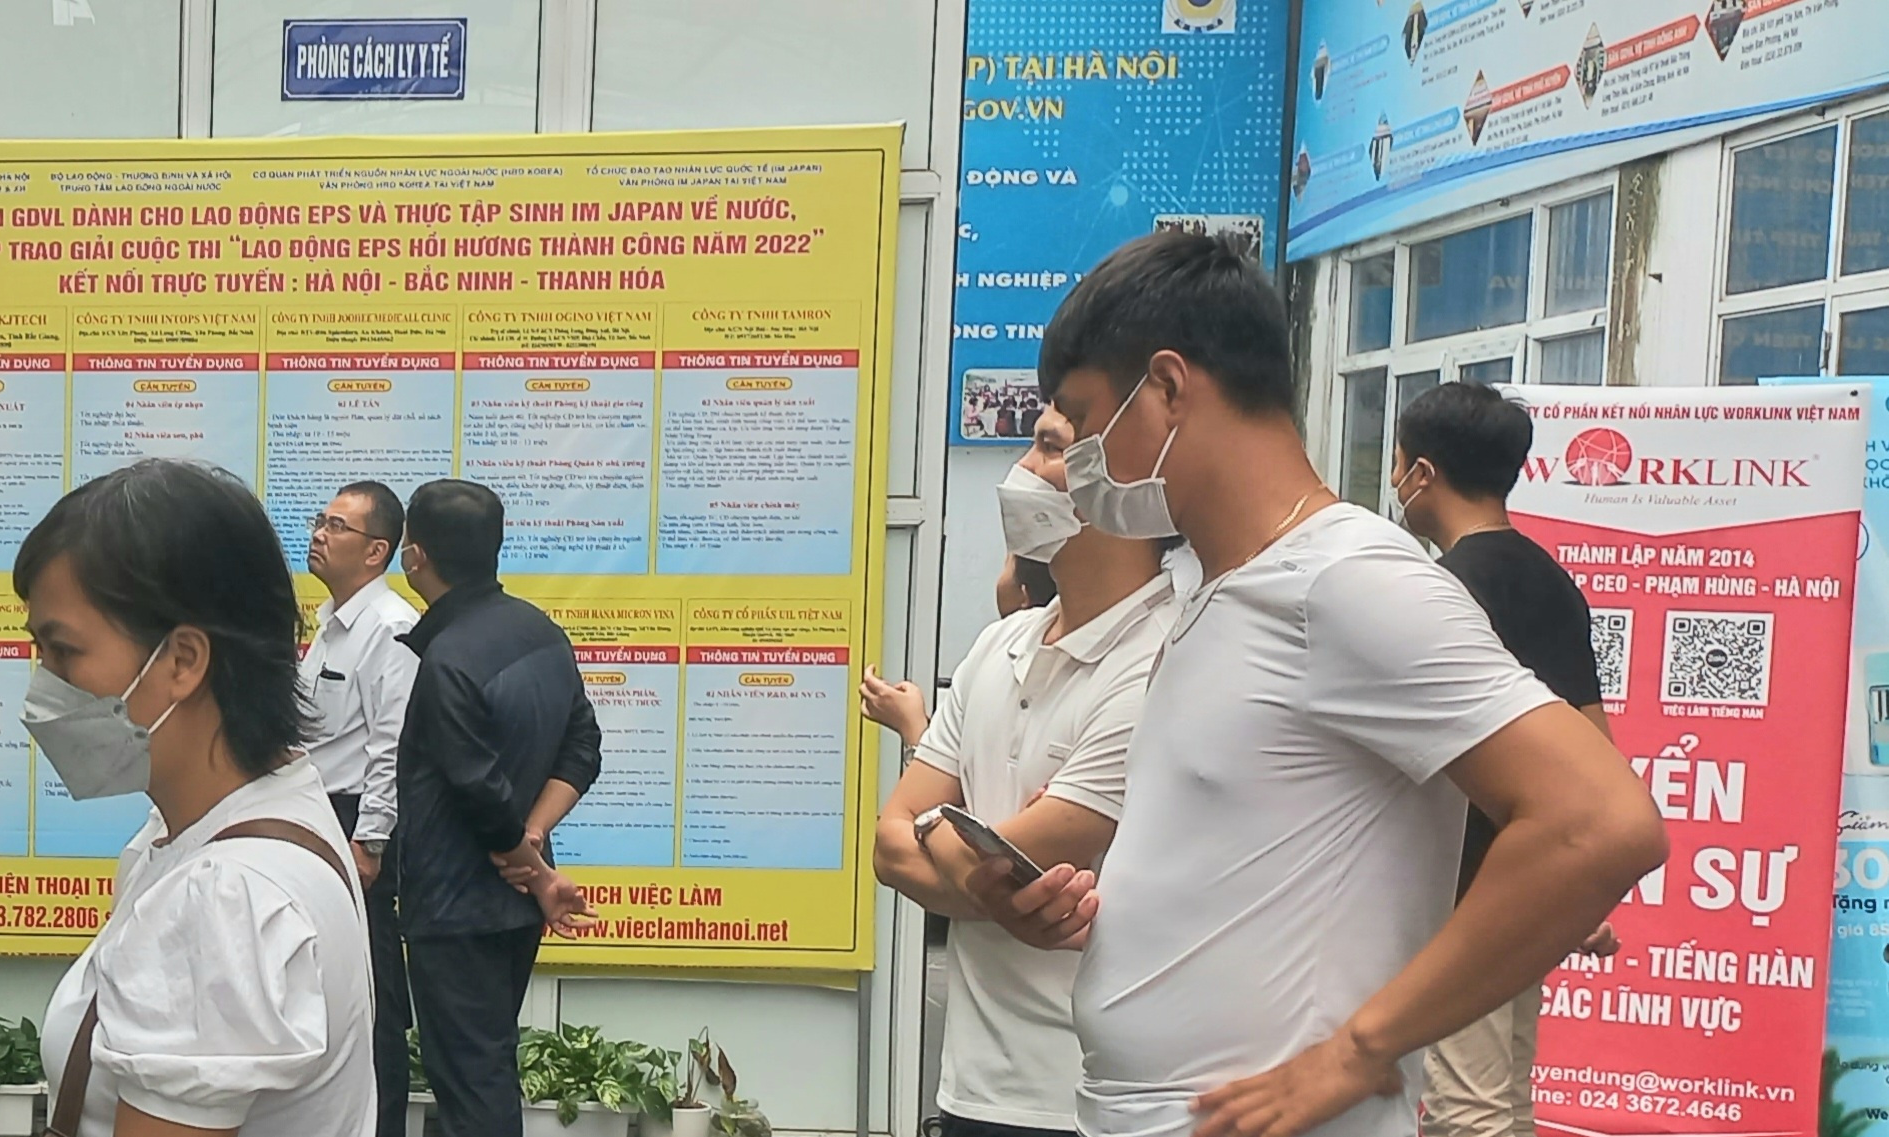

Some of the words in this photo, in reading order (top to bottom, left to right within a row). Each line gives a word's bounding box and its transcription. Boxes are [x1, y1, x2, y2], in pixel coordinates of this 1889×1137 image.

[297, 36, 350, 79] PHÒNG
[353, 36, 394, 79] CÁCH
[398, 43, 415, 78] LY
[420, 43, 428, 78] Y
[432, 32, 452, 78] TẾ
[1004, 56, 1055, 84] TẠI
[1063, 49, 1107, 80] HÀ
[1115, 51, 1177, 85] NỘI
[967, 169, 1038, 188] ĐỘNG
[1046, 168, 1077, 184] VÀ
[11, 207, 64, 227] GDVL
[72, 202, 132, 227] DÀNH
[140, 205, 183, 226] CHO
[191, 206, 232, 226] LAO
[239, 202, 300, 230] ĐỘNG
[308, 204, 350, 225] EPS
[358, 199, 387, 224] VÀ
[395, 201, 451, 228] THỰC
[459, 200, 501, 228] TẬP
[509, 202, 564, 222] SINH
[572, 202, 600, 221] IM
[608, 201, 683, 221] JAPAN
[725, 194, 797, 223] NƯỚC,
[9, 241, 63, 260] TRAO
[69, 233, 114, 259] GIẢI
[121, 234, 180, 264] CUỘC
[188, 239, 221, 259] THI
[230, 234, 282, 258] “LAO
[289, 235, 350, 262] ĐỘNG
[358, 238, 399, 257] EPS
[454, 233, 531, 257] HƯƠNG
[539, 230, 614, 256] THÀNH
[622, 229, 684, 255] CÔNG
[693, 229, 746, 255] NĂM
[754, 228, 825, 254] 2022”
[151, 271, 207, 297] TRỰC
[305, 267, 335, 291] HÀ
[342, 268, 381, 296] NỘI
[457, 271, 513, 291] NINH
[537, 270, 612, 290] THANH
[619, 265, 665, 289] HÓA
[978, 272, 1067, 291] NGHIỆP
[1655, 403, 1689, 420] NHÂN
[1694, 406, 1719, 423] LỰC
[1797, 405, 1824, 424] VIỆT
[1558, 543, 1617, 564] THÀNH
[1621, 544, 1656, 568] LẬP
[1661, 545, 1705, 566] NĂM
[1709, 549, 1755, 568] 2014
[1592, 576, 1627, 592] CEO
[1645, 577, 1699, 598] PHẠM
[1705, 574, 1756, 596] HÙNG
[1775, 576, 1801, 597] HÀ
[1806, 579, 1840, 601] NỘI
[36, 875, 90, 898] THOẠI
[629, 883, 672, 908] VIỆC
[679, 884, 722, 906] LÀM
[1690, 845, 1798, 927] SỰ
[1649, 940, 1737, 985] TIẾNG
[1747, 950, 1814, 989] HÀN
[1602, 985, 1670, 1026] LĨNH
[1681, 996, 1741, 1037] VỰC
[1579, 1090, 1619, 1110] 024
[1626, 1094, 1741, 1122] 3672.4646
